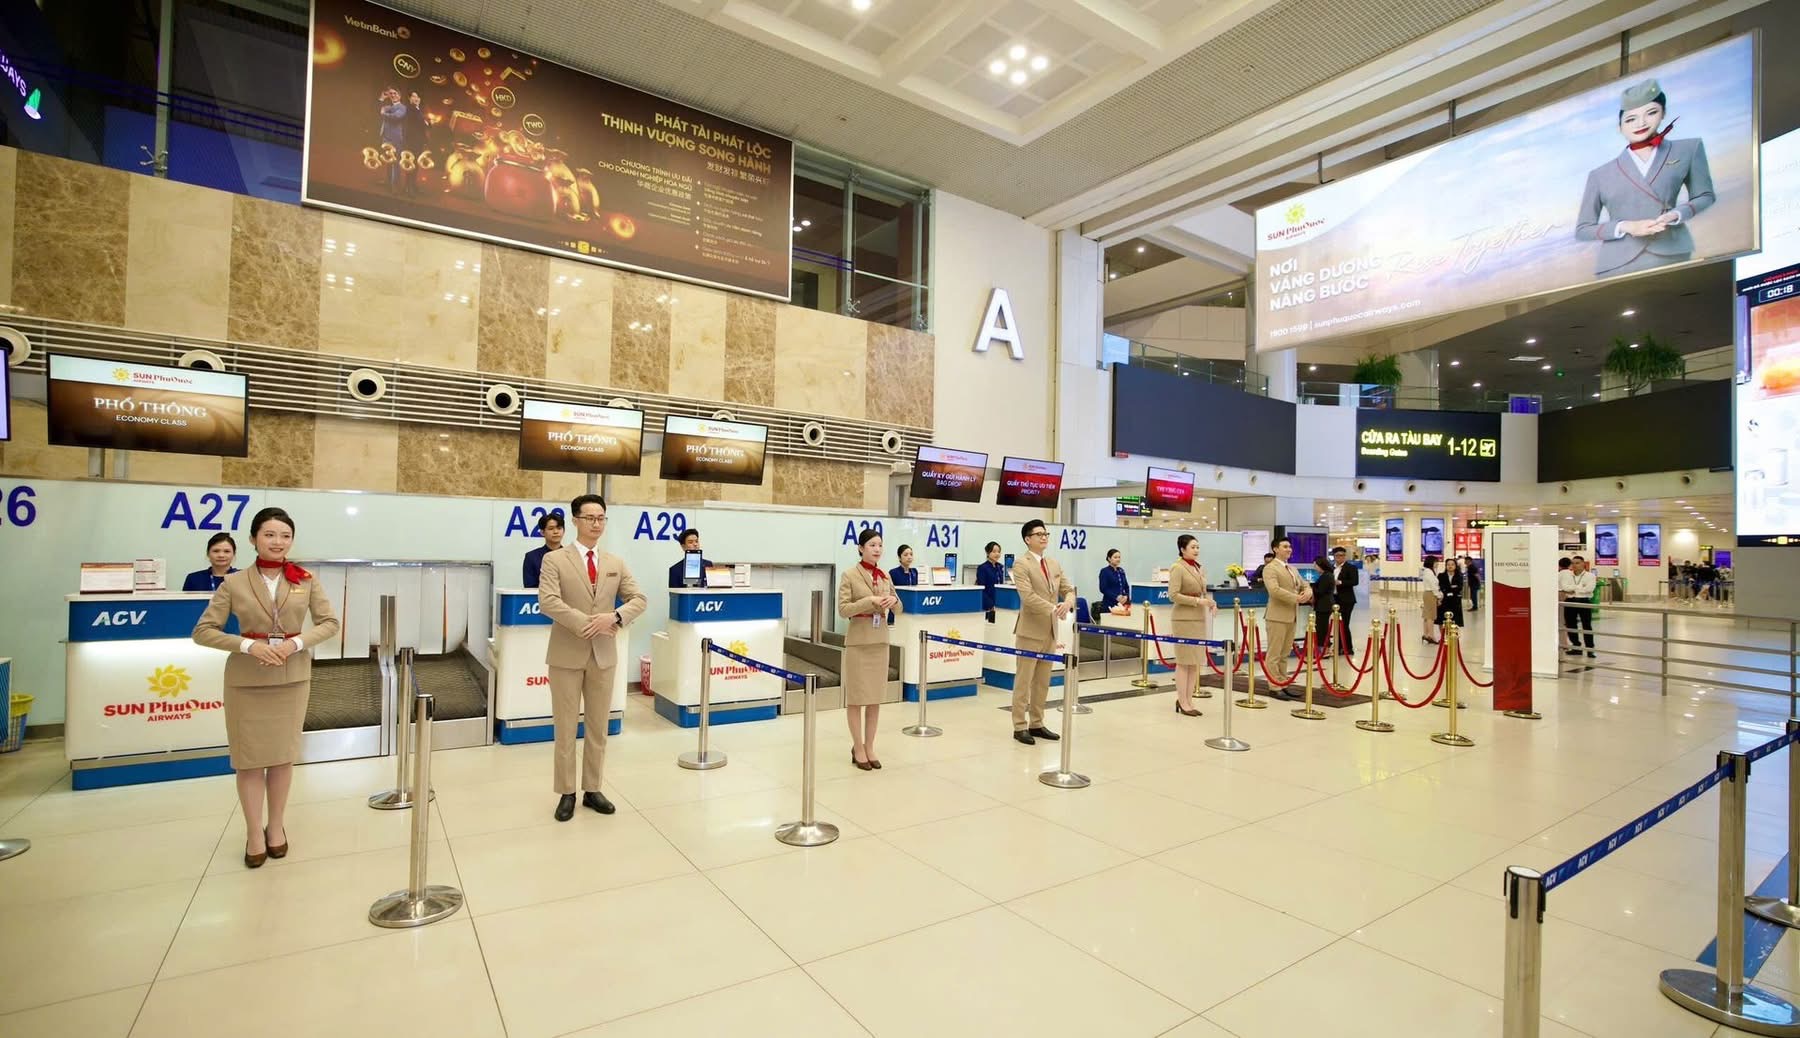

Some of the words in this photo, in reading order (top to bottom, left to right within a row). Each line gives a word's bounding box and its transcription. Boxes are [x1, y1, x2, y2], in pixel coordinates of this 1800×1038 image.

[344, 15, 398, 39] VietinBank
[397, 58, 416, 73] CNY
[526, 119, 543, 129] TWD
[601, 113, 643, 136] THỊNH
[646, 127, 696, 151] VƯỢNG
[698, 143, 736, 164] SONG
[738, 154, 771, 174] HÀNH
[655, 112, 689, 133] PHÁT
[691, 124, 710, 141] TÀI
[713, 131, 745, 150] PHÁT
[747, 142, 771, 160] LỘC
[598, 160, 614, 171] CHO
[615, 165, 639, 177] DOANH
[664, 179, 678, 187] HOA
[1267, 229, 1285, 240] SUN
[1767, 285, 1793, 298] 00:18
[971, 287, 1024, 360] A
[133, 372, 153, 380] SUN
[138, 401, 207, 418] THÔNG
[115, 414, 159, 424] ECONOMY
[160, 418, 187, 426] CLASS
[575, 433, 617, 446] THÔNG
[1361, 429, 1384, 444] CỬA
[1385, 432, 1400, 445] RA
[1400, 430, 1421, 445] TÀU
[1422, 433, 1443, 446] BAY
[1447, 436, 1478, 456] 1-12
[709, 446, 744, 457] THÔNG
[0, 485, 37, 527] 6
[160, 491, 250, 531] A27
[633, 511, 687, 542] A29
[926, 523, 959, 548] A31
[1059, 528, 1087, 550] A32
[518, 602, 540, 615] AC
[695, 600, 723, 612] ACV
[922, 596, 942, 606] ACV
[92, 610, 147, 626] ACV
[929, 651, 944, 660] SUN
[710, 666, 724, 675] UN
[104, 702, 146, 717] SUN
[149, 699, 225, 714] PhuQuo
[147, 713, 192, 722] AIRWAYS
[1545, 871, 1557, 888] ACV
[1578, 853, 1589, 869] ACV
[1608, 836, 1617, 850] ACV
[1634, 820, 1643, 834] ACV
